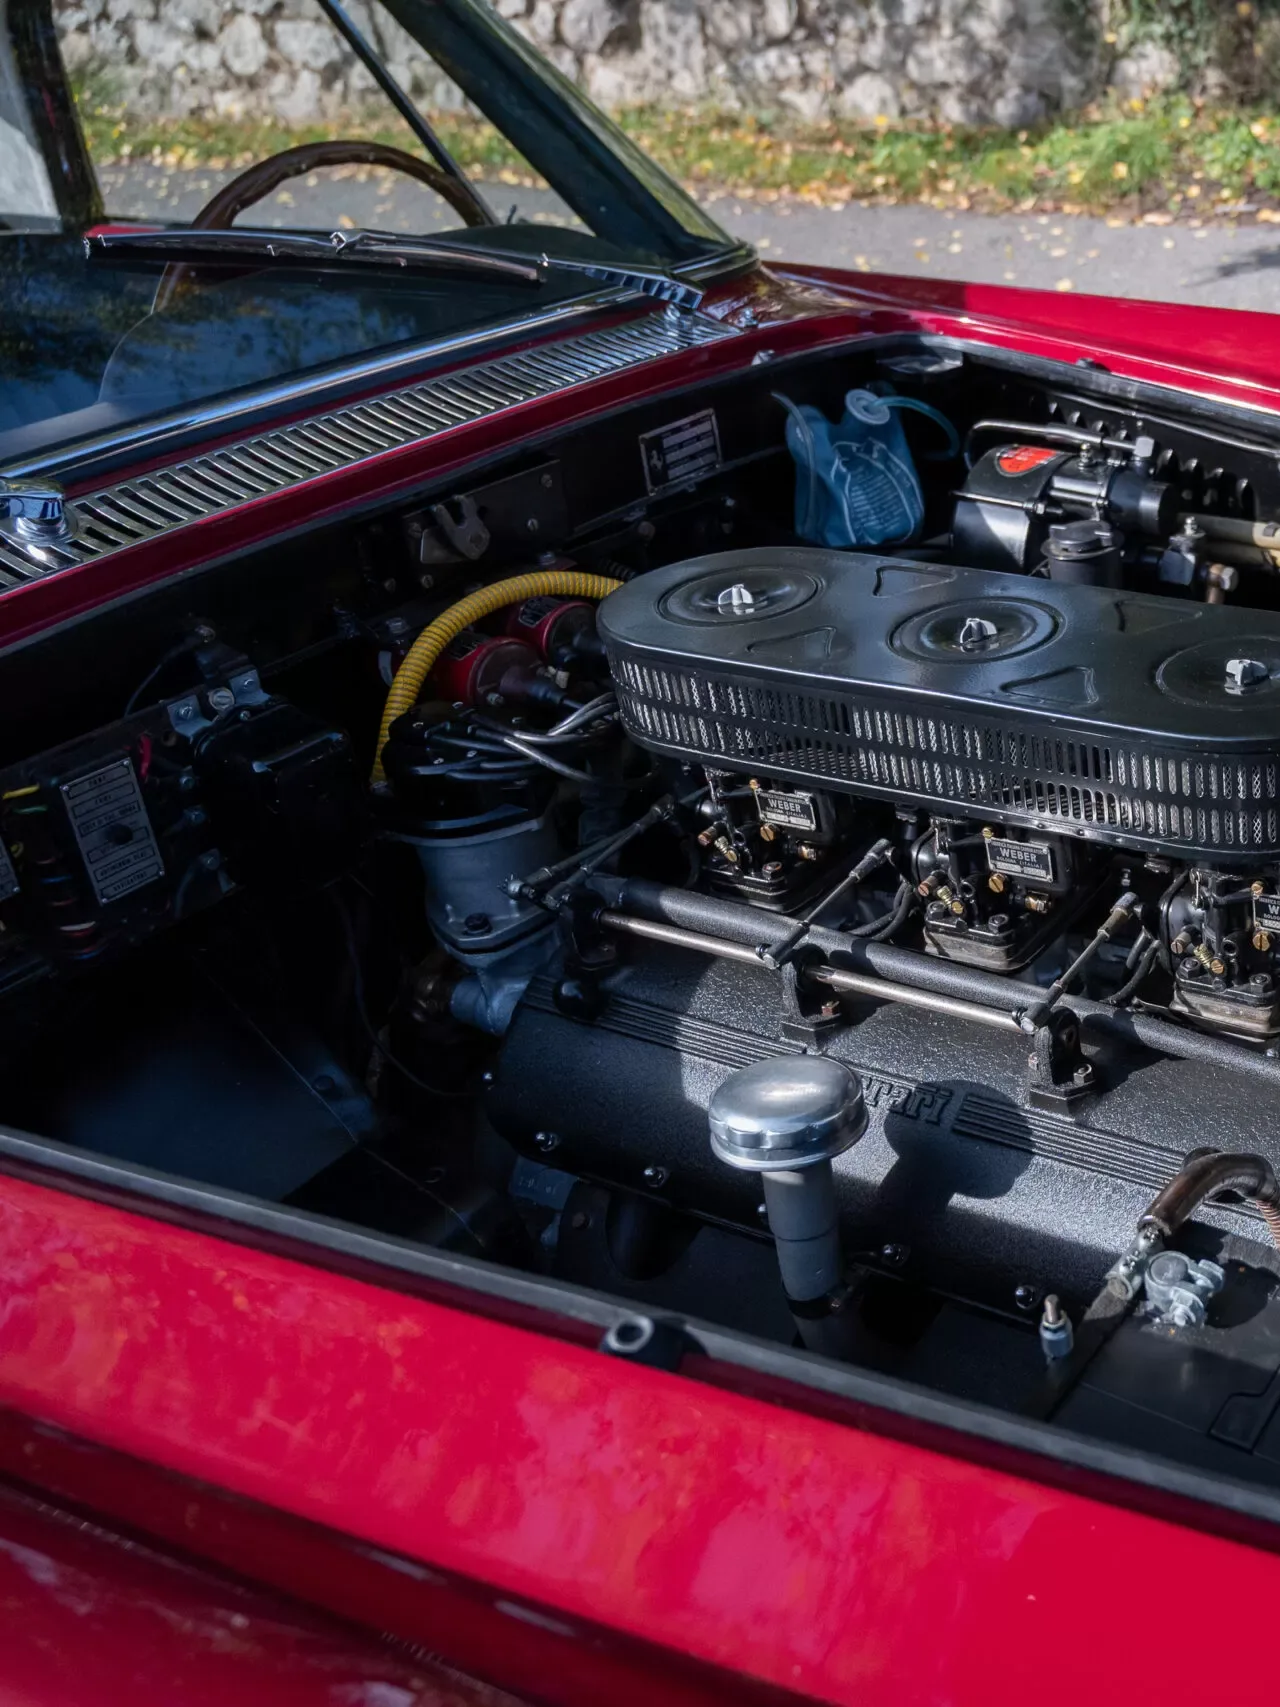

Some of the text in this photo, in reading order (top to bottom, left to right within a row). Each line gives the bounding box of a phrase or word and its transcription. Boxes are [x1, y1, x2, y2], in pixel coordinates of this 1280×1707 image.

[768, 798, 801, 813] WEBER
[1000, 847, 1037, 862] WEBER
[862, 1074, 953, 1126] rari
